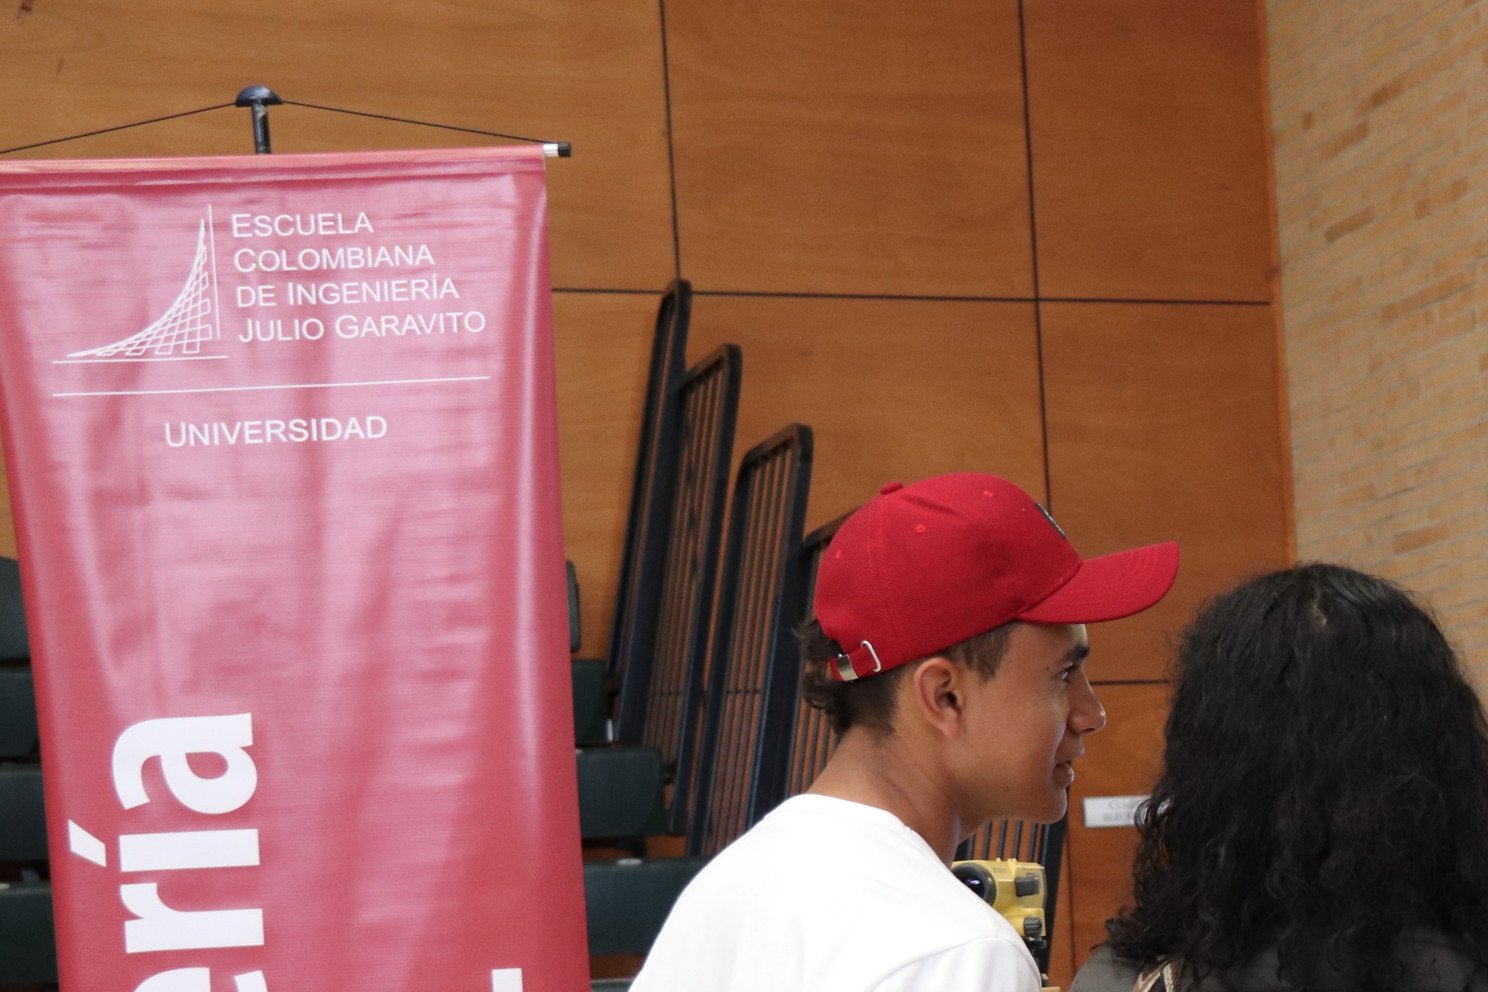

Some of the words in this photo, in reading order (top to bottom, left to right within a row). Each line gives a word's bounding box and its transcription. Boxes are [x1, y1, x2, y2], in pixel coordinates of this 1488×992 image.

[230, 212, 375, 238] ESCUELA
[233, 244, 436, 272] COLOMBIANA
[236, 285, 277, 308] DE
[287, 274, 460, 306] INGENIERÍA
[238, 317, 325, 343] JULIO
[334, 310, 487, 339] GARAVITO
[164, 415, 388, 448] UNIVERSIDAD
